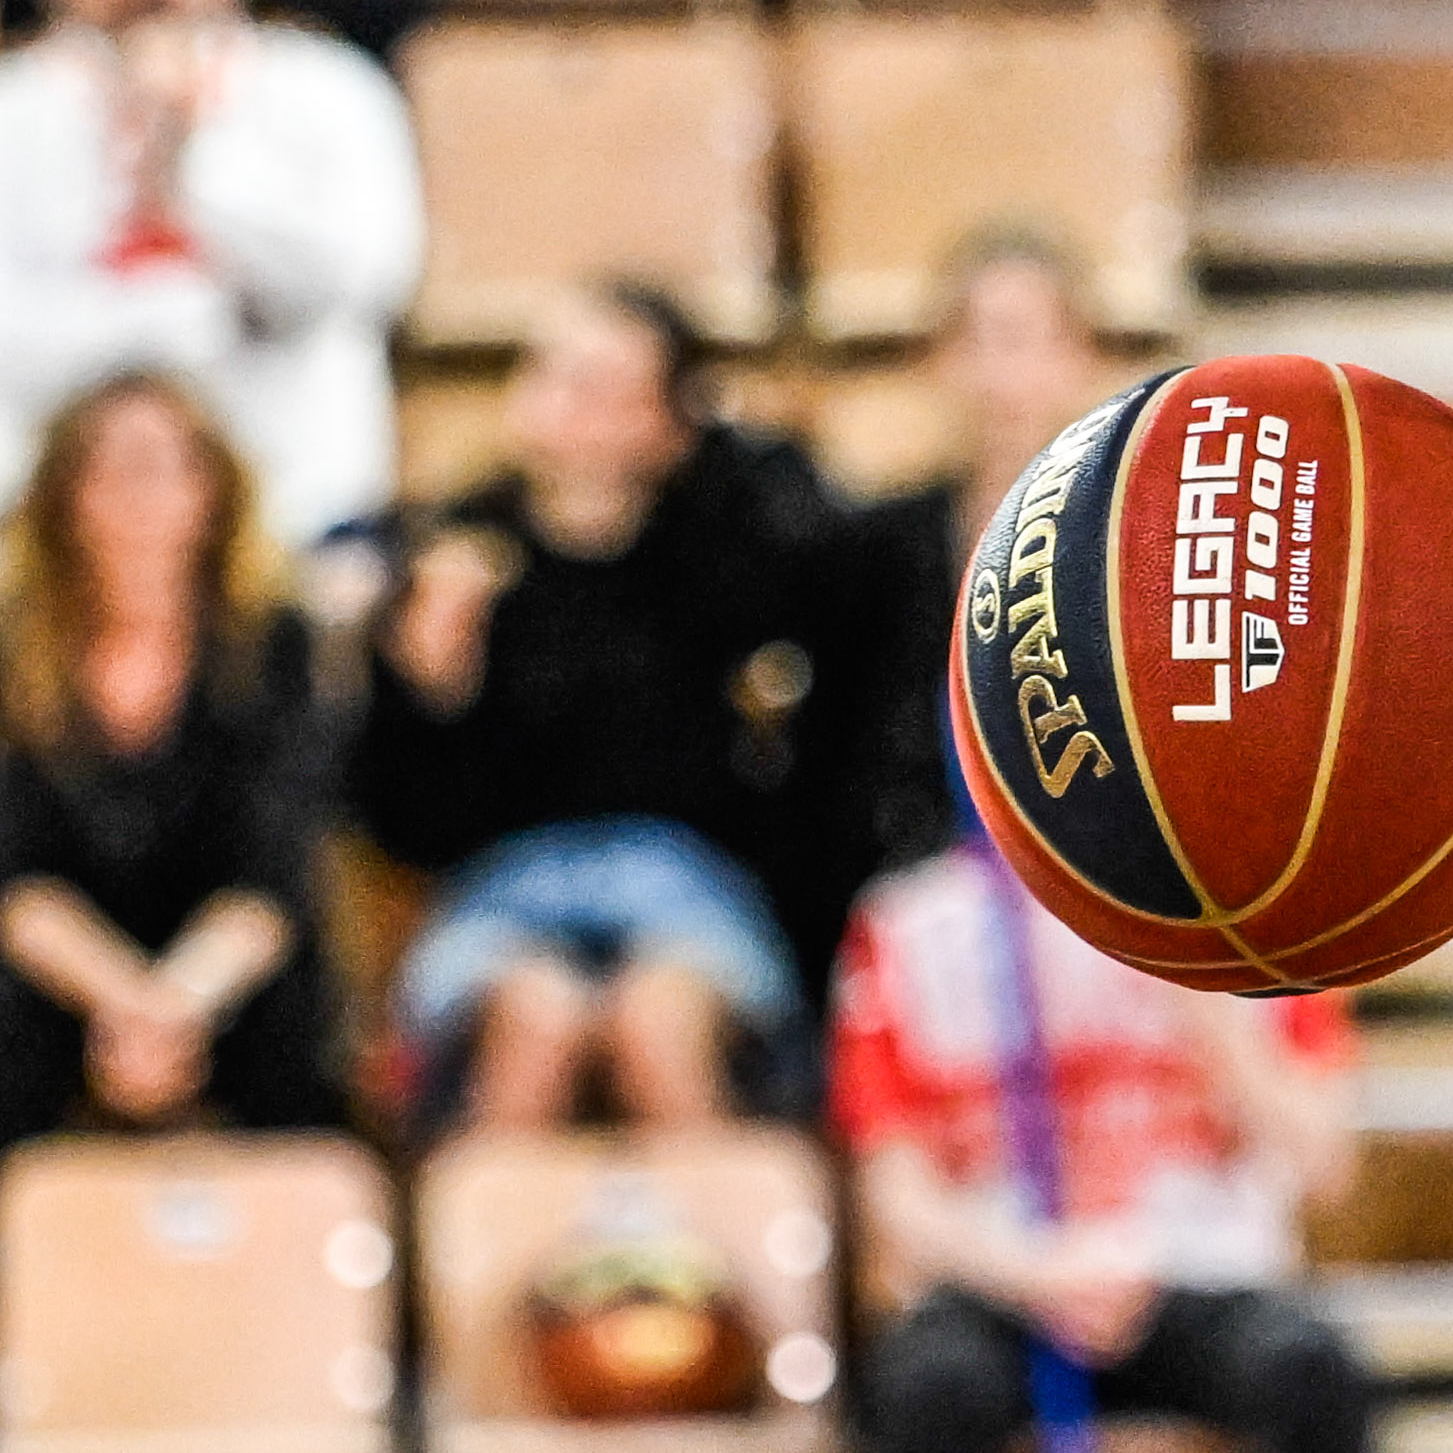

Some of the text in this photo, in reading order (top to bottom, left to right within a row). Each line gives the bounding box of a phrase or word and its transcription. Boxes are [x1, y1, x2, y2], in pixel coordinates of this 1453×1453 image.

[1171, 395, 1249, 722] LEGACY
[1244, 414, 1290, 603] 1000
[1288, 459, 1319, 626] OFFICIAL GAME BALL
